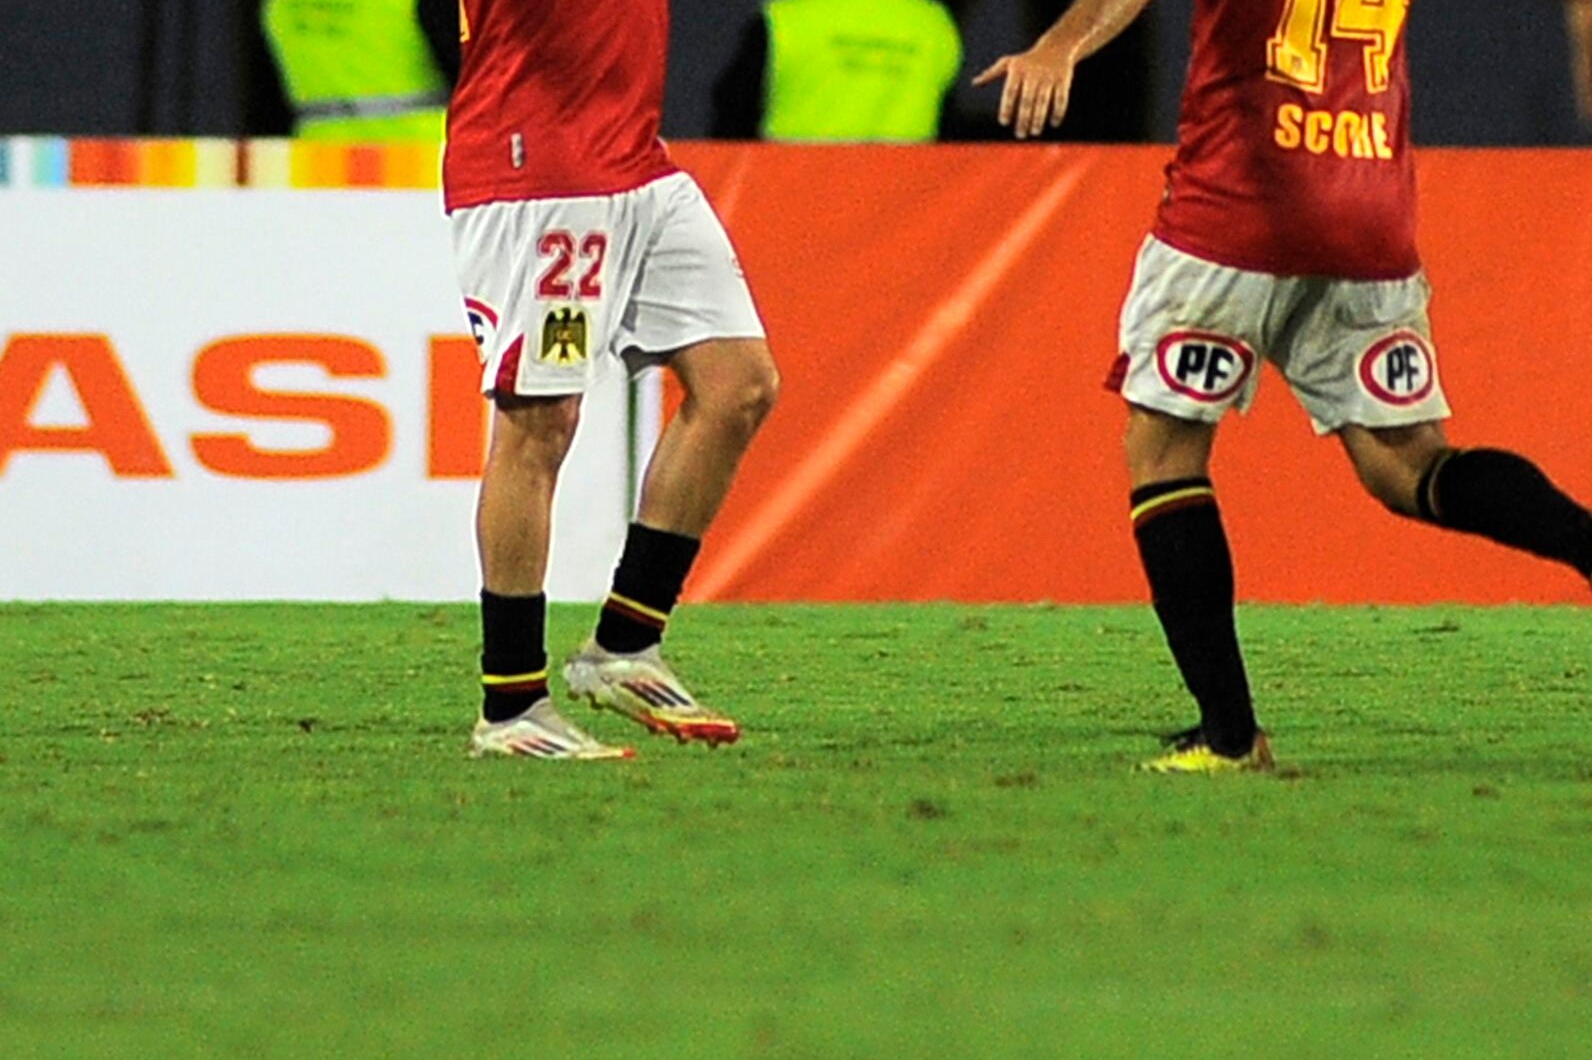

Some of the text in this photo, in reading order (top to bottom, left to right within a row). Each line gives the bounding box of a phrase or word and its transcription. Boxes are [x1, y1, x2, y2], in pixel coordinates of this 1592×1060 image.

[535, 230, 608, 300] 22
[1175, 343, 1235, 391] PF
[1385, 344, 1420, 392] PF
